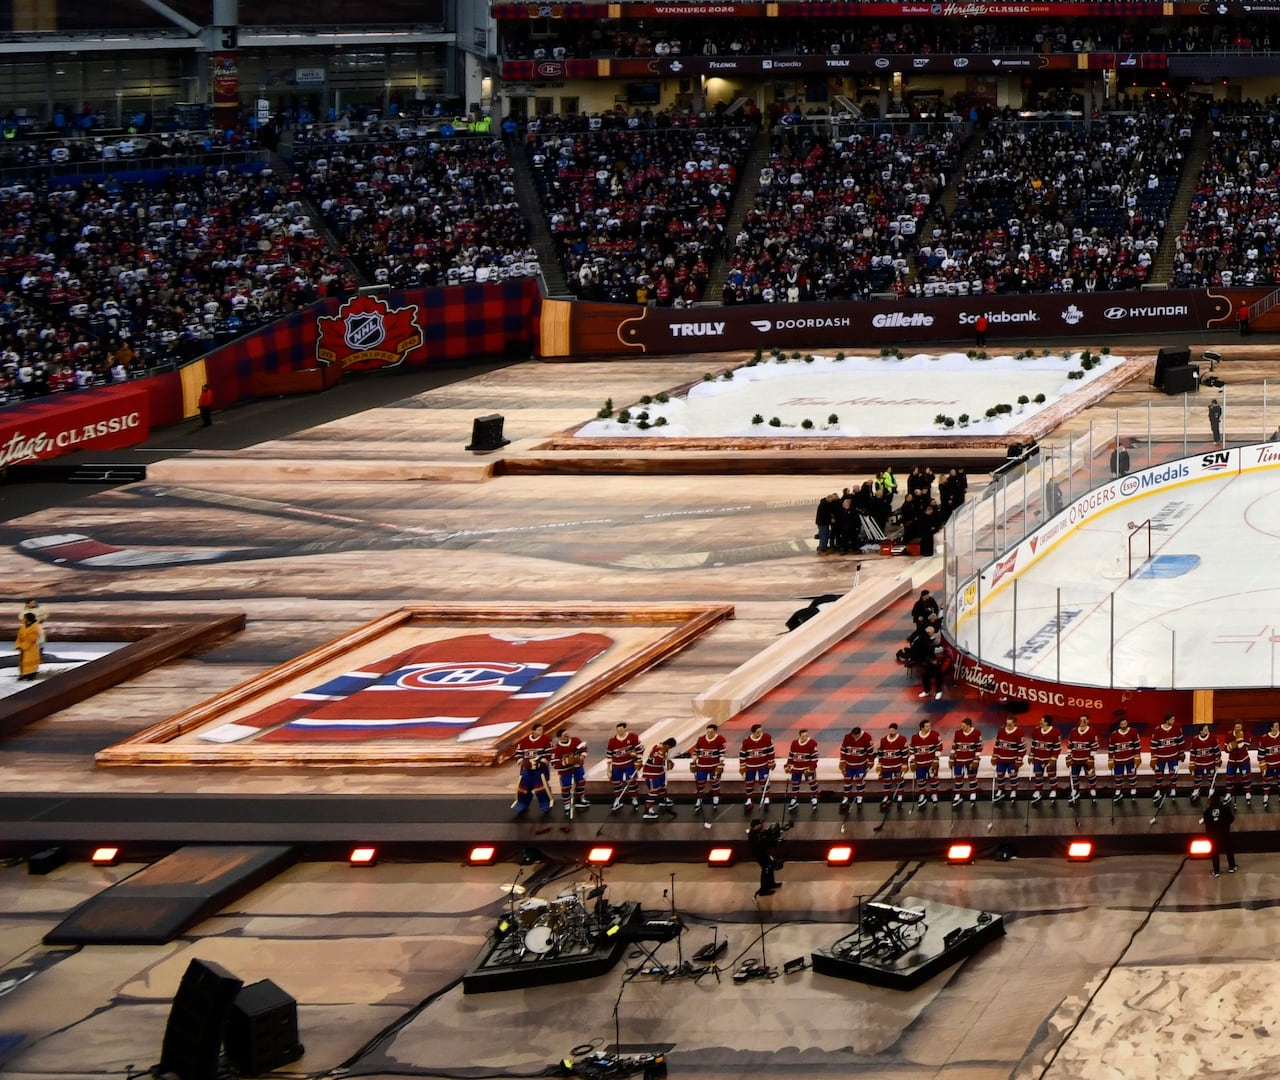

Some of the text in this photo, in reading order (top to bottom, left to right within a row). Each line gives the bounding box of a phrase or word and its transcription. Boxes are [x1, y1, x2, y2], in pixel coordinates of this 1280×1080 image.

[222, 26, 237, 49] 3
[825, 59, 850, 67] TRULY
[871, 311, 935, 328] Gillette
[1129, 305, 1188, 318] HYUNDAI
[353, 320, 377, 342] NHL
[669, 322, 726, 337] TRULY
[775, 317, 850, 330] DOORDASH
[56, 412, 140, 447] CLASSIC
[1201, 451, 1230, 468] SN
[1122, 463, 1190, 491] Esso Medals
[1077, 485, 1116, 520] ROGERS
[952, 654, 1103, 709] Heritage CLASSIC 2026
